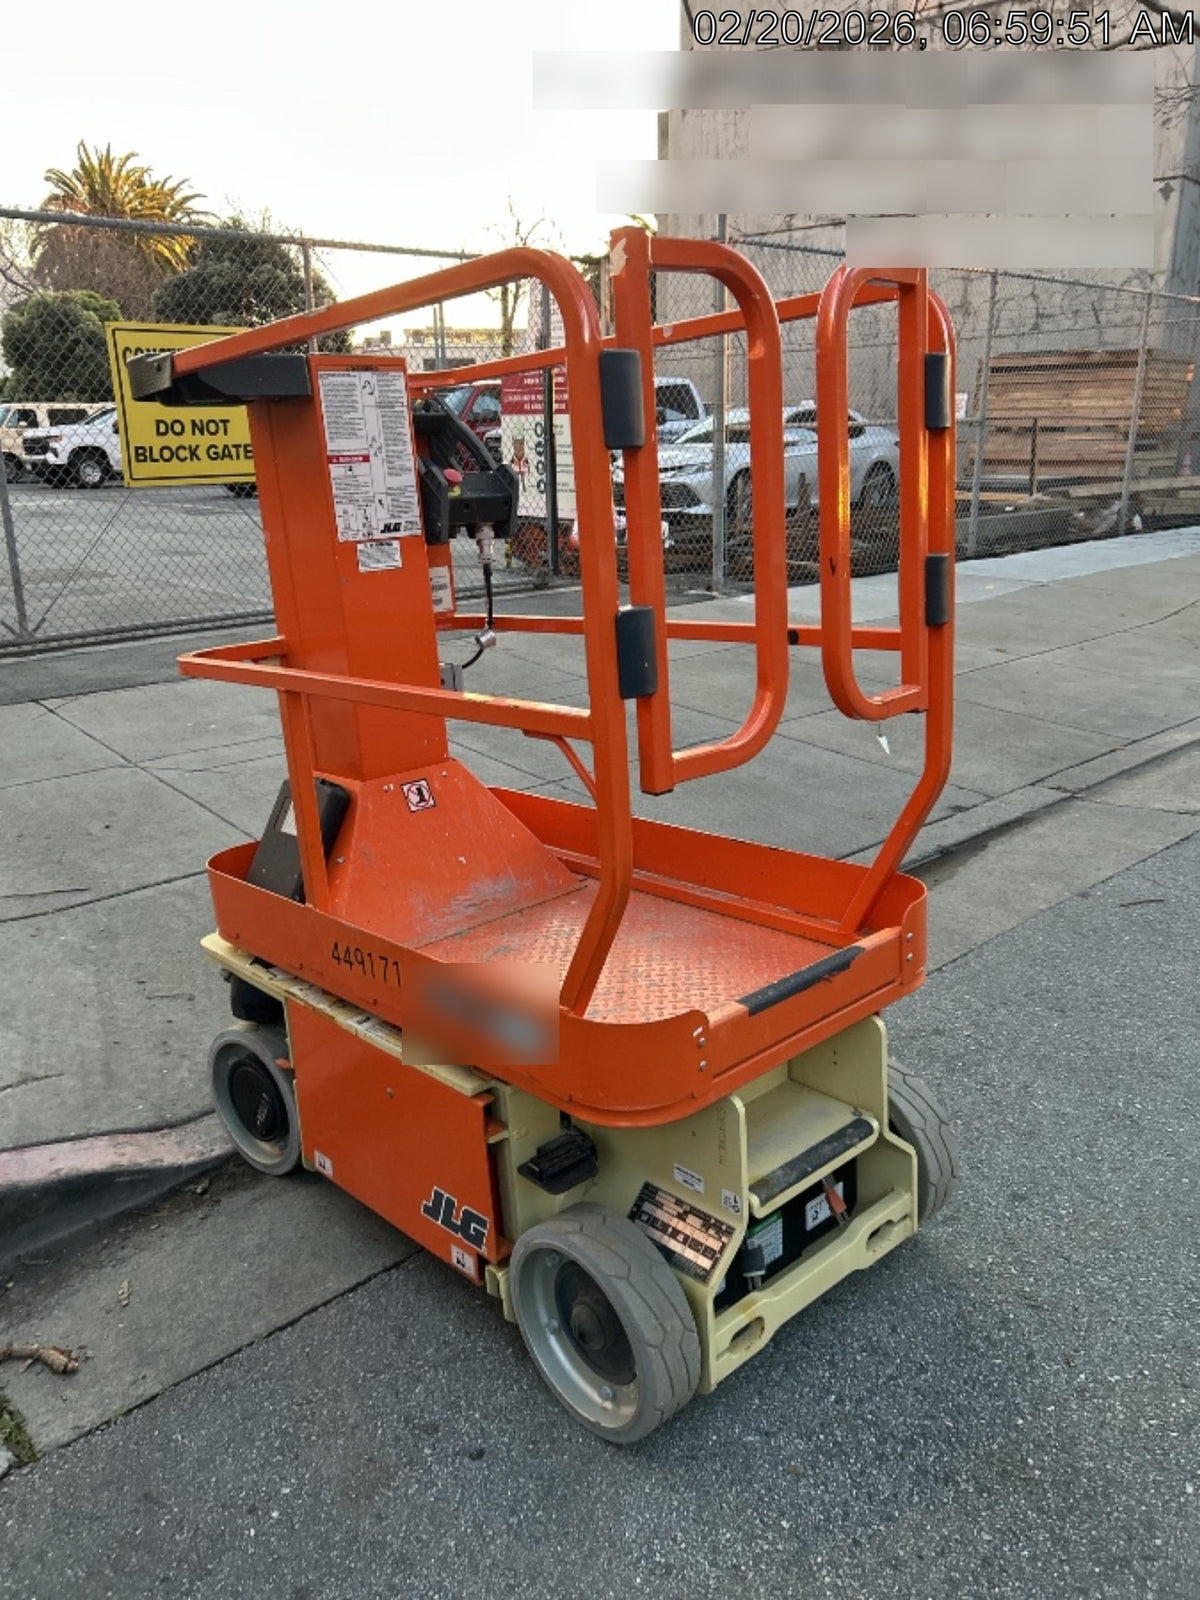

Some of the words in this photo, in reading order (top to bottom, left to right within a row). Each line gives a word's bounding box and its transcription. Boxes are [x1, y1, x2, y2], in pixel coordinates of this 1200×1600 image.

[155, 419, 184, 436] DO
[191, 419, 230, 436] NOT
[135, 445, 201, 463] BLOCK
[206, 444, 253, 461] GATE
[331, 942, 402, 987] 449171
[421, 1186, 488, 1252] JLG
